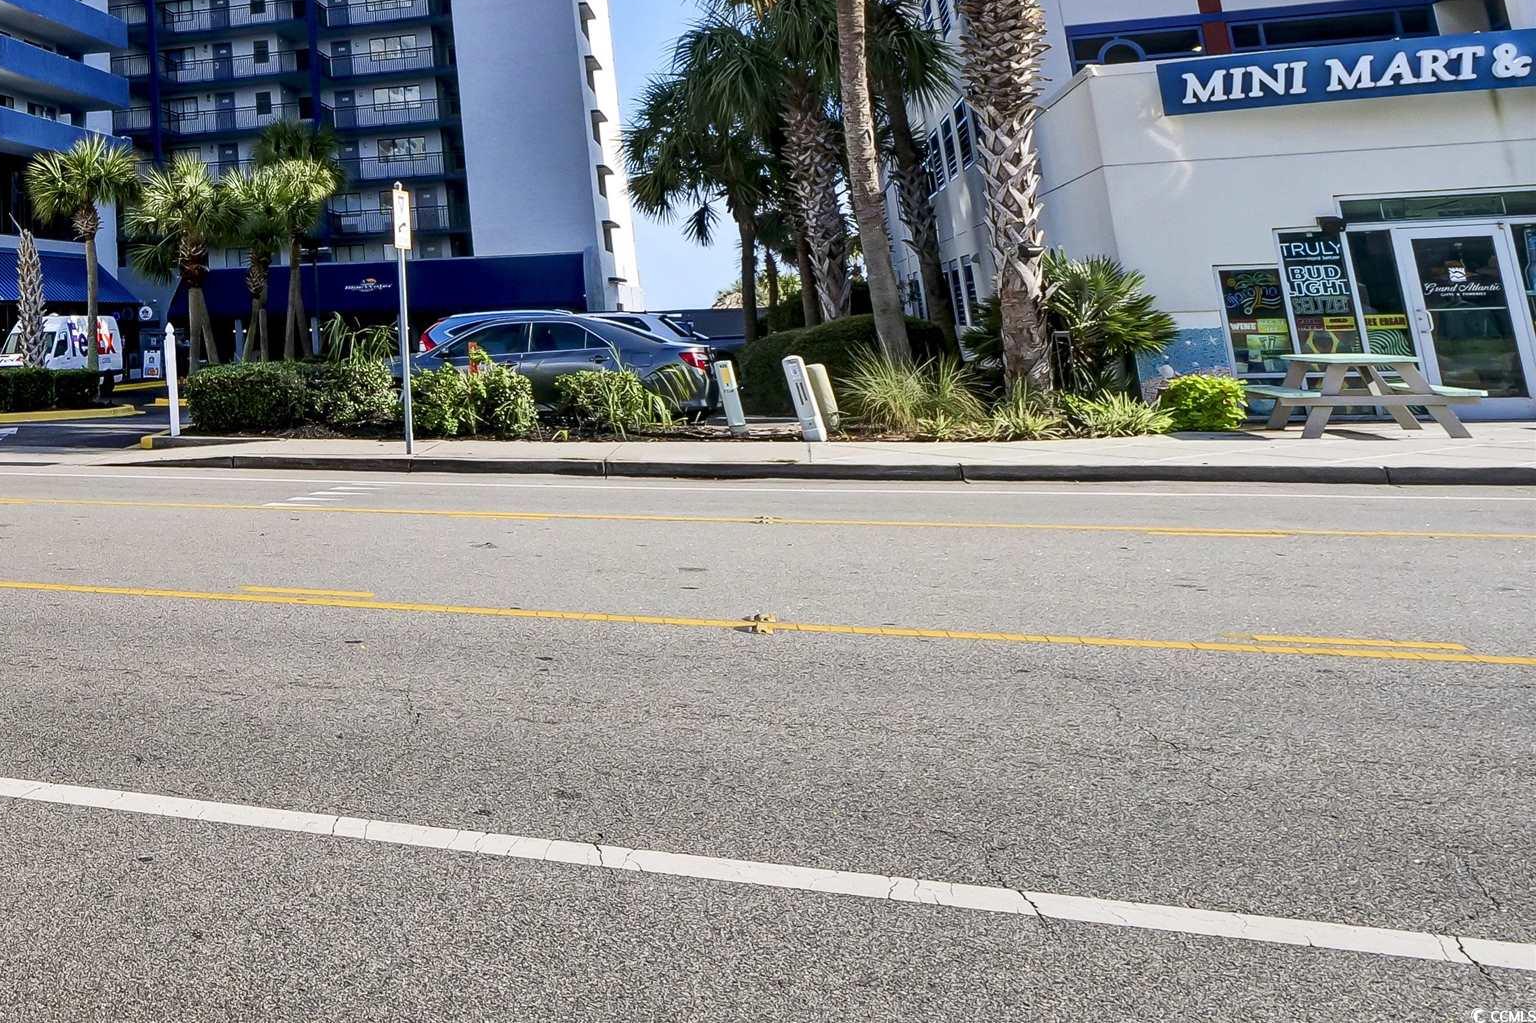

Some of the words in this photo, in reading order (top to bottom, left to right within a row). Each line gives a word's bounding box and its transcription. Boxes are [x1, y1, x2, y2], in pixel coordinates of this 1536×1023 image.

[1182, 61, 1308, 104] MINI
[1325, 45, 1485, 91] MART
[1492, 43, 1532, 78] &
[1279, 241, 1341, 256] TRULY
[1288, 265, 1341, 281] BUD
[1424, 282, 1458, 296] Grand
[1458, 281, 1502, 292] Atlantic
[67, 321, 116, 357] FeEx
